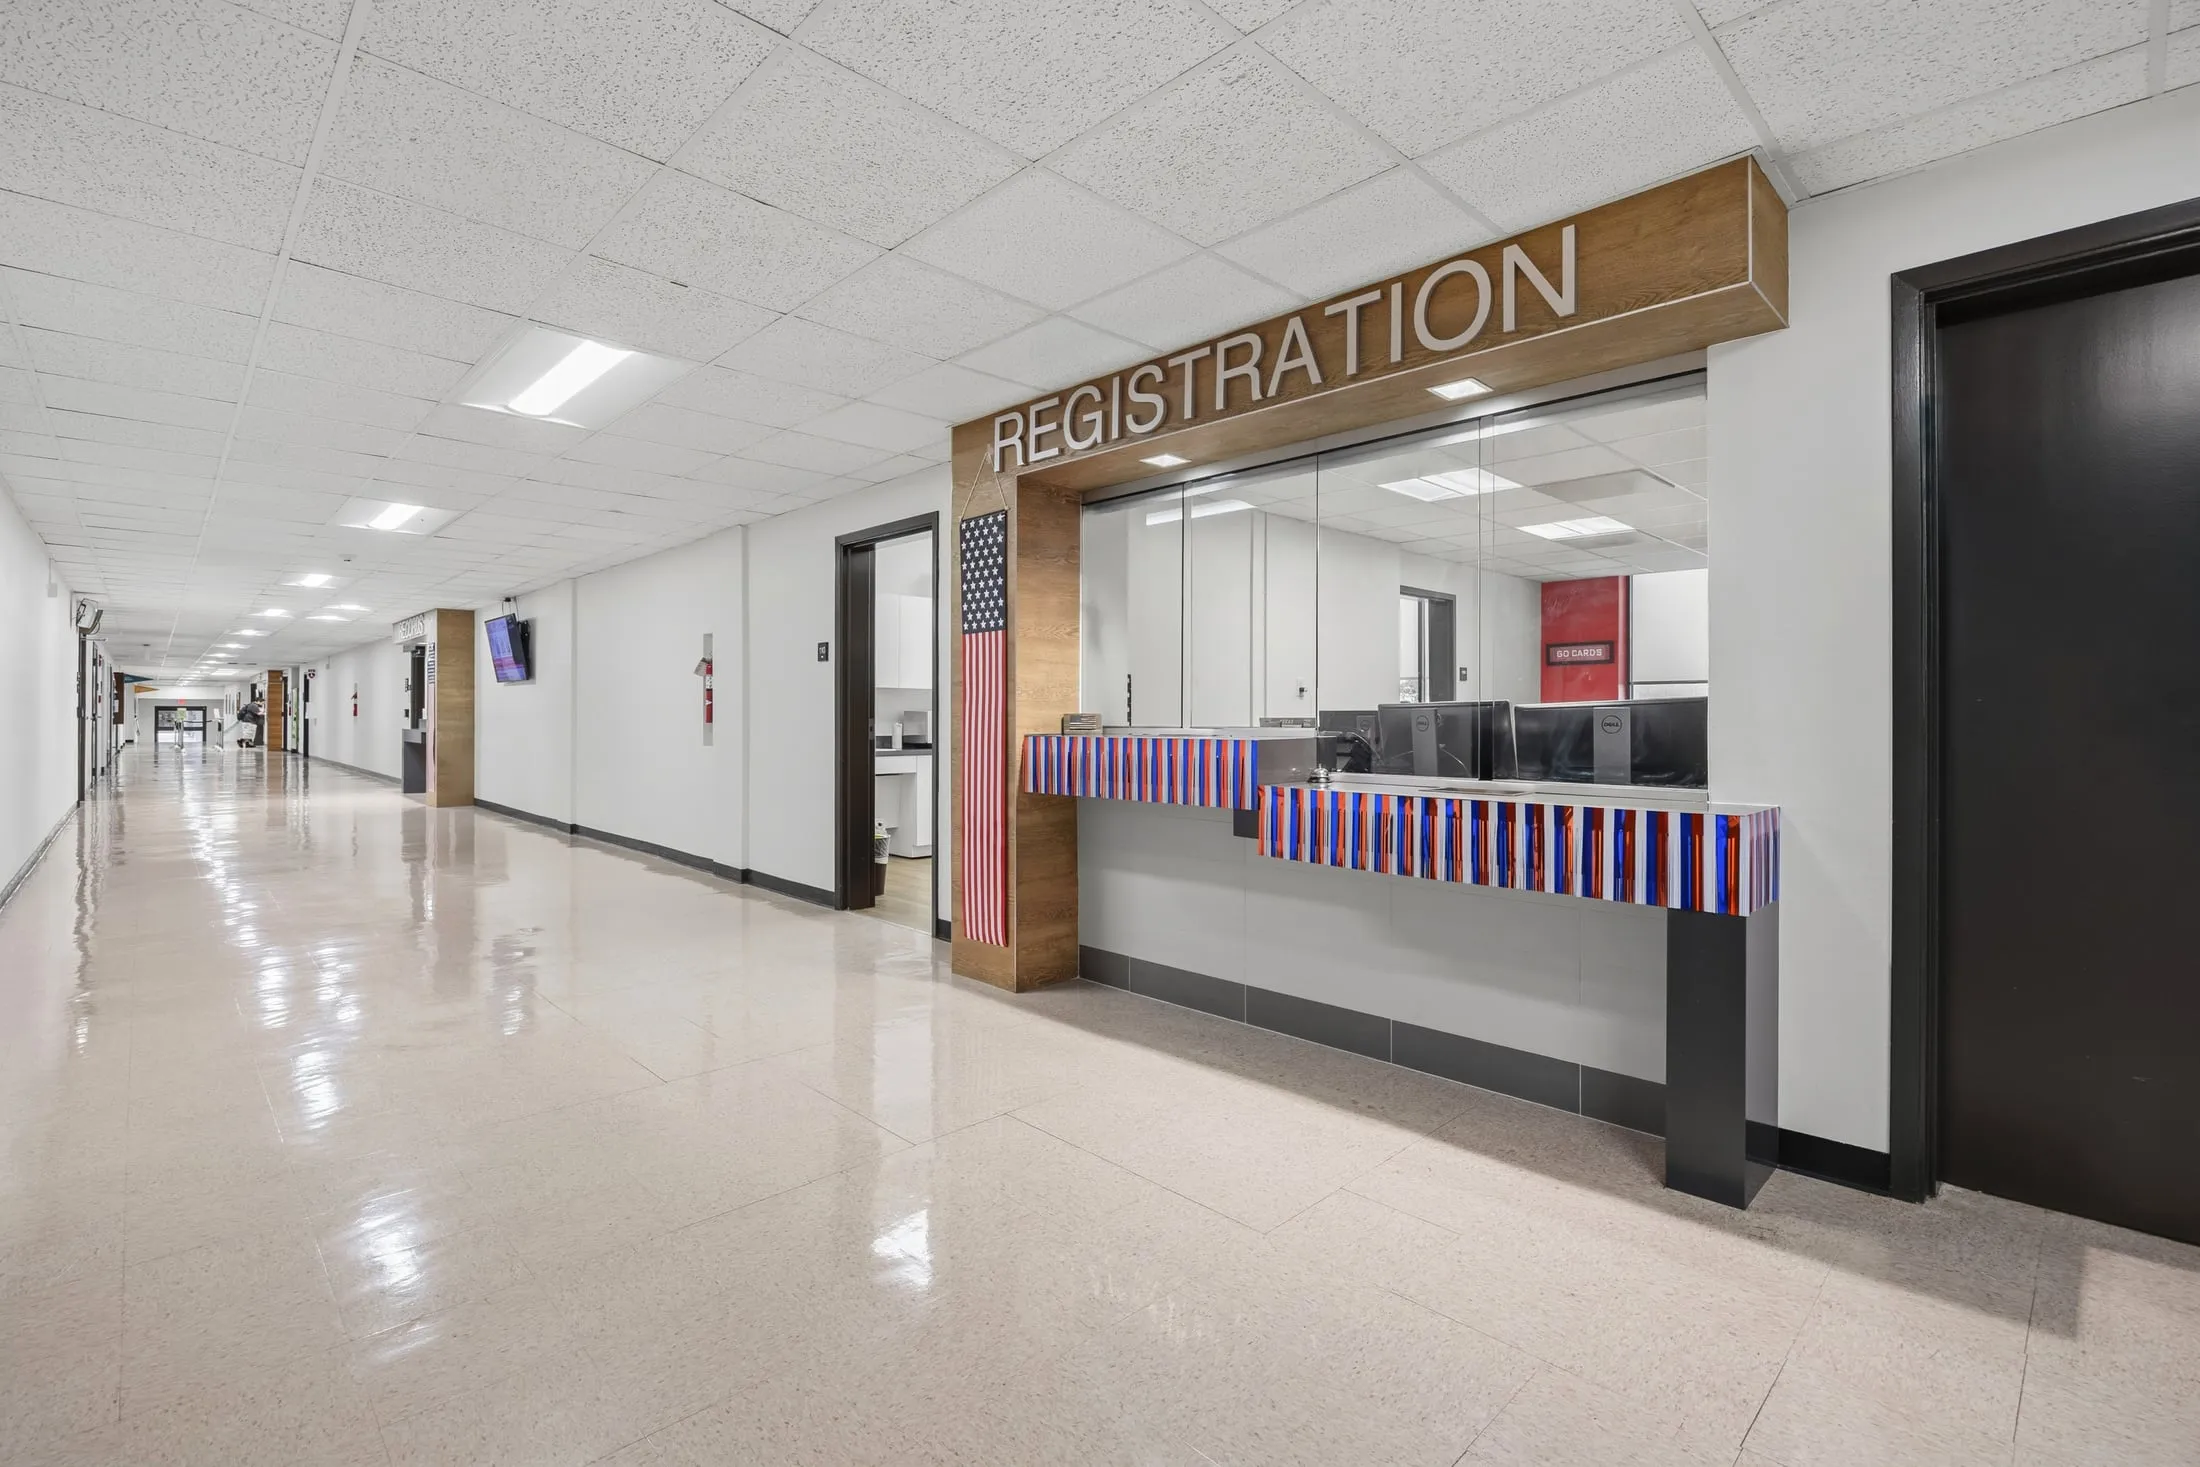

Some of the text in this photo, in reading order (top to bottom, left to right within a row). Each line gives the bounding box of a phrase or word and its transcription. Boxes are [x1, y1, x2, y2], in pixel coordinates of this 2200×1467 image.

[992, 224, 1577, 473] REGISTRATION
[1556, 648, 1603, 658] GO CARDS
